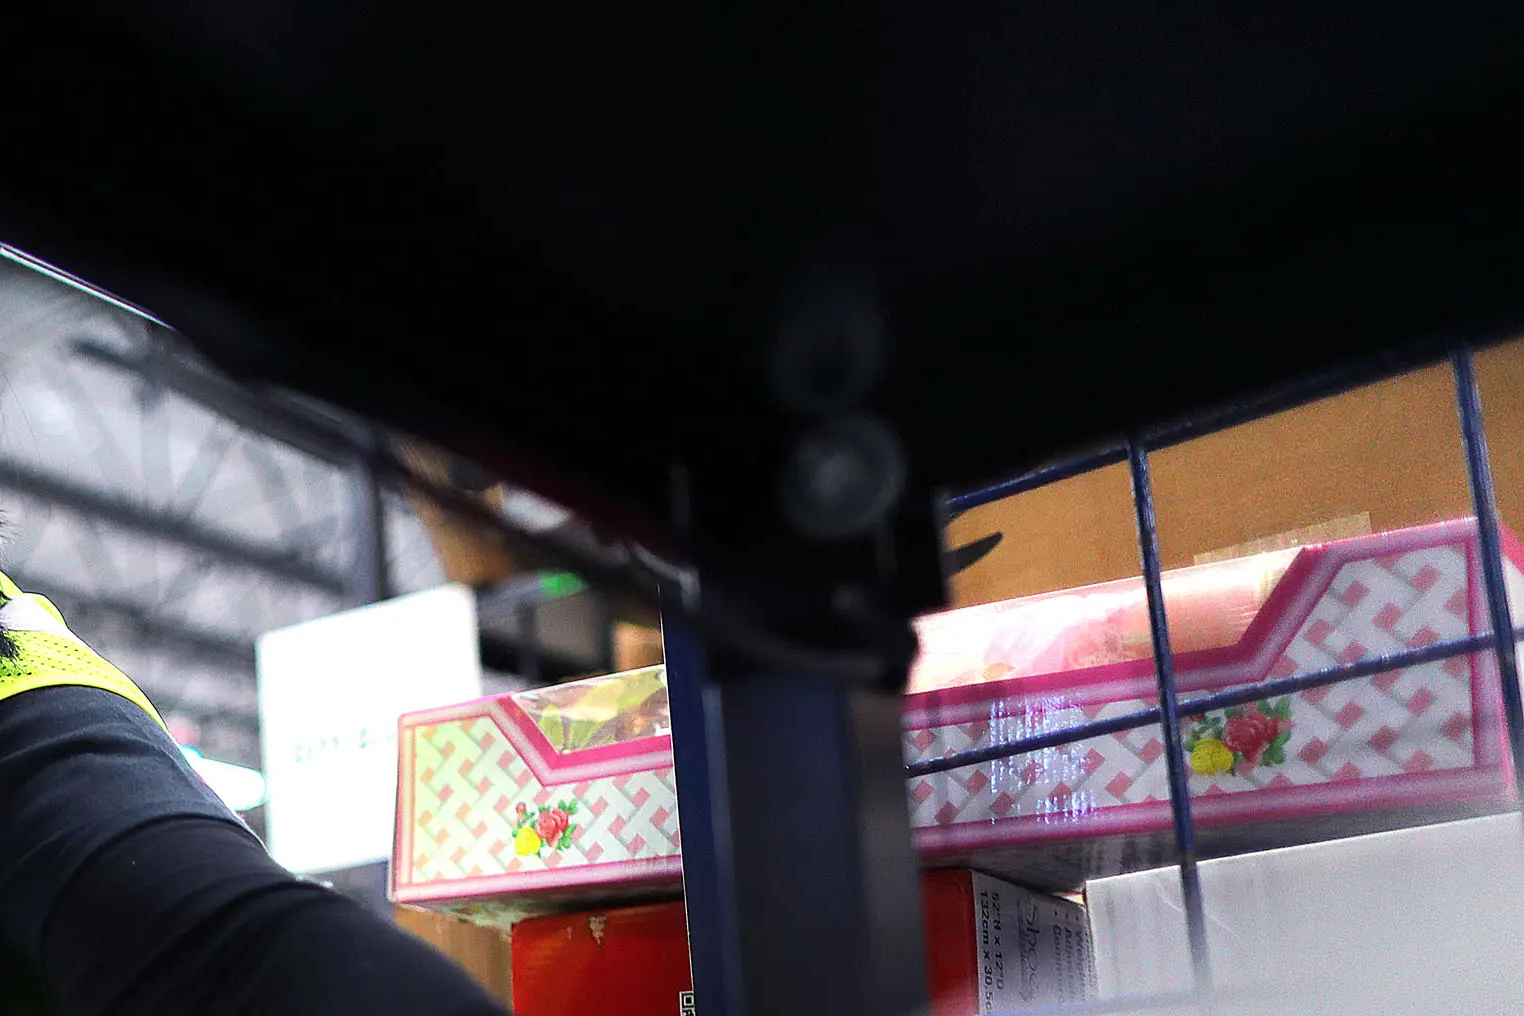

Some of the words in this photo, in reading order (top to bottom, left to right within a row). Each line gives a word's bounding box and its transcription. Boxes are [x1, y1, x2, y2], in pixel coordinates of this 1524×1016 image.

[980, 890, 990, 945] 132cm
[983, 950, 991, 961] x
[994, 935, 1002, 947] x
[984, 965, 994, 1014] 30.5c
[995, 951, 1005, 991] 12"D
